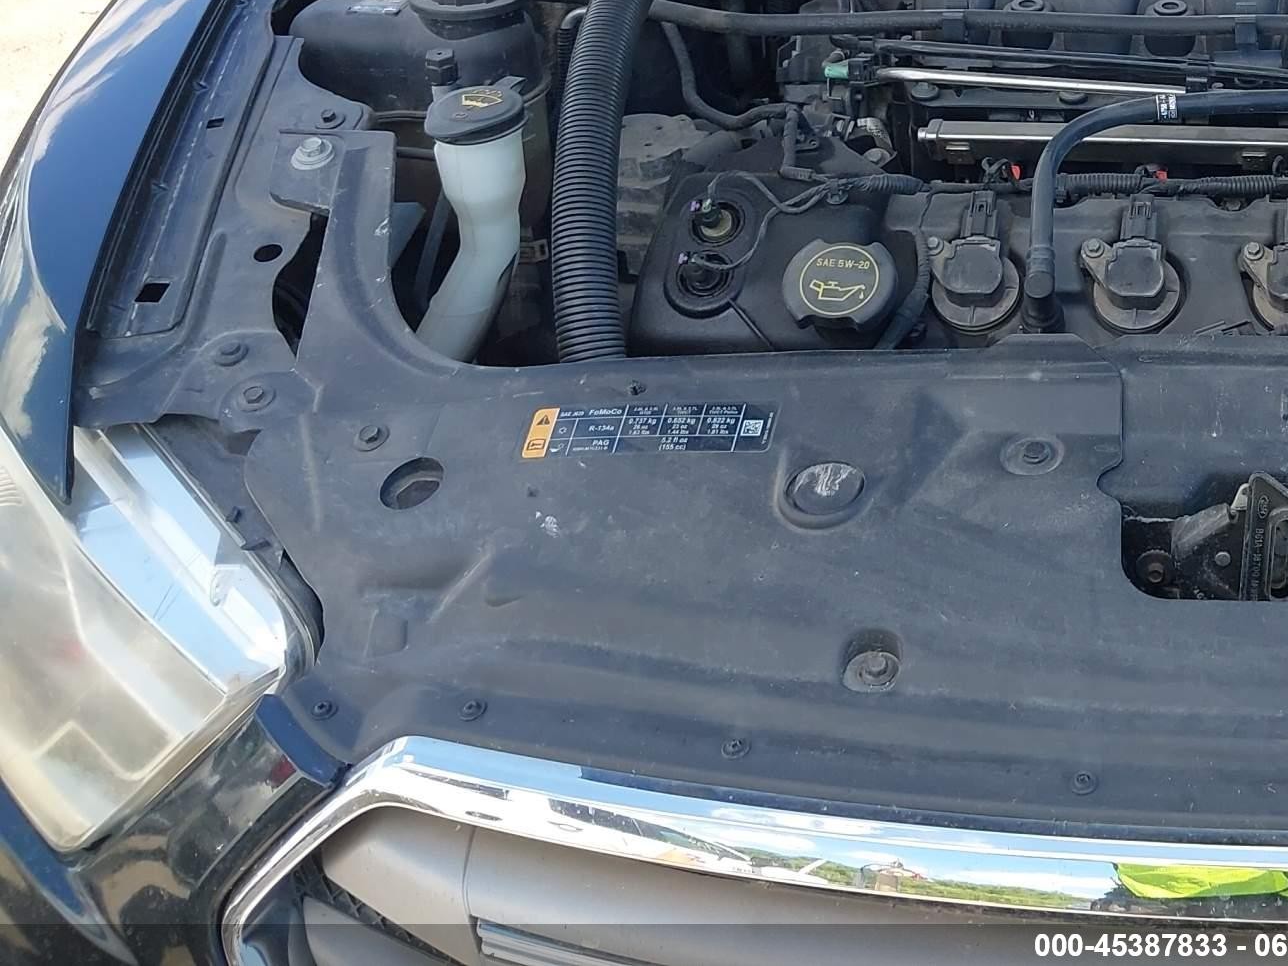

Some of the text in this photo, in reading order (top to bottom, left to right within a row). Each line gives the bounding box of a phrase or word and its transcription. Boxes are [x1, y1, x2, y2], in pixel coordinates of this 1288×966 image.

[816, 258, 870, 269] SAE 5W-20
[588, 408, 623, 416] FoMoCo
[658, 443, 687, 451] (155 cc)
